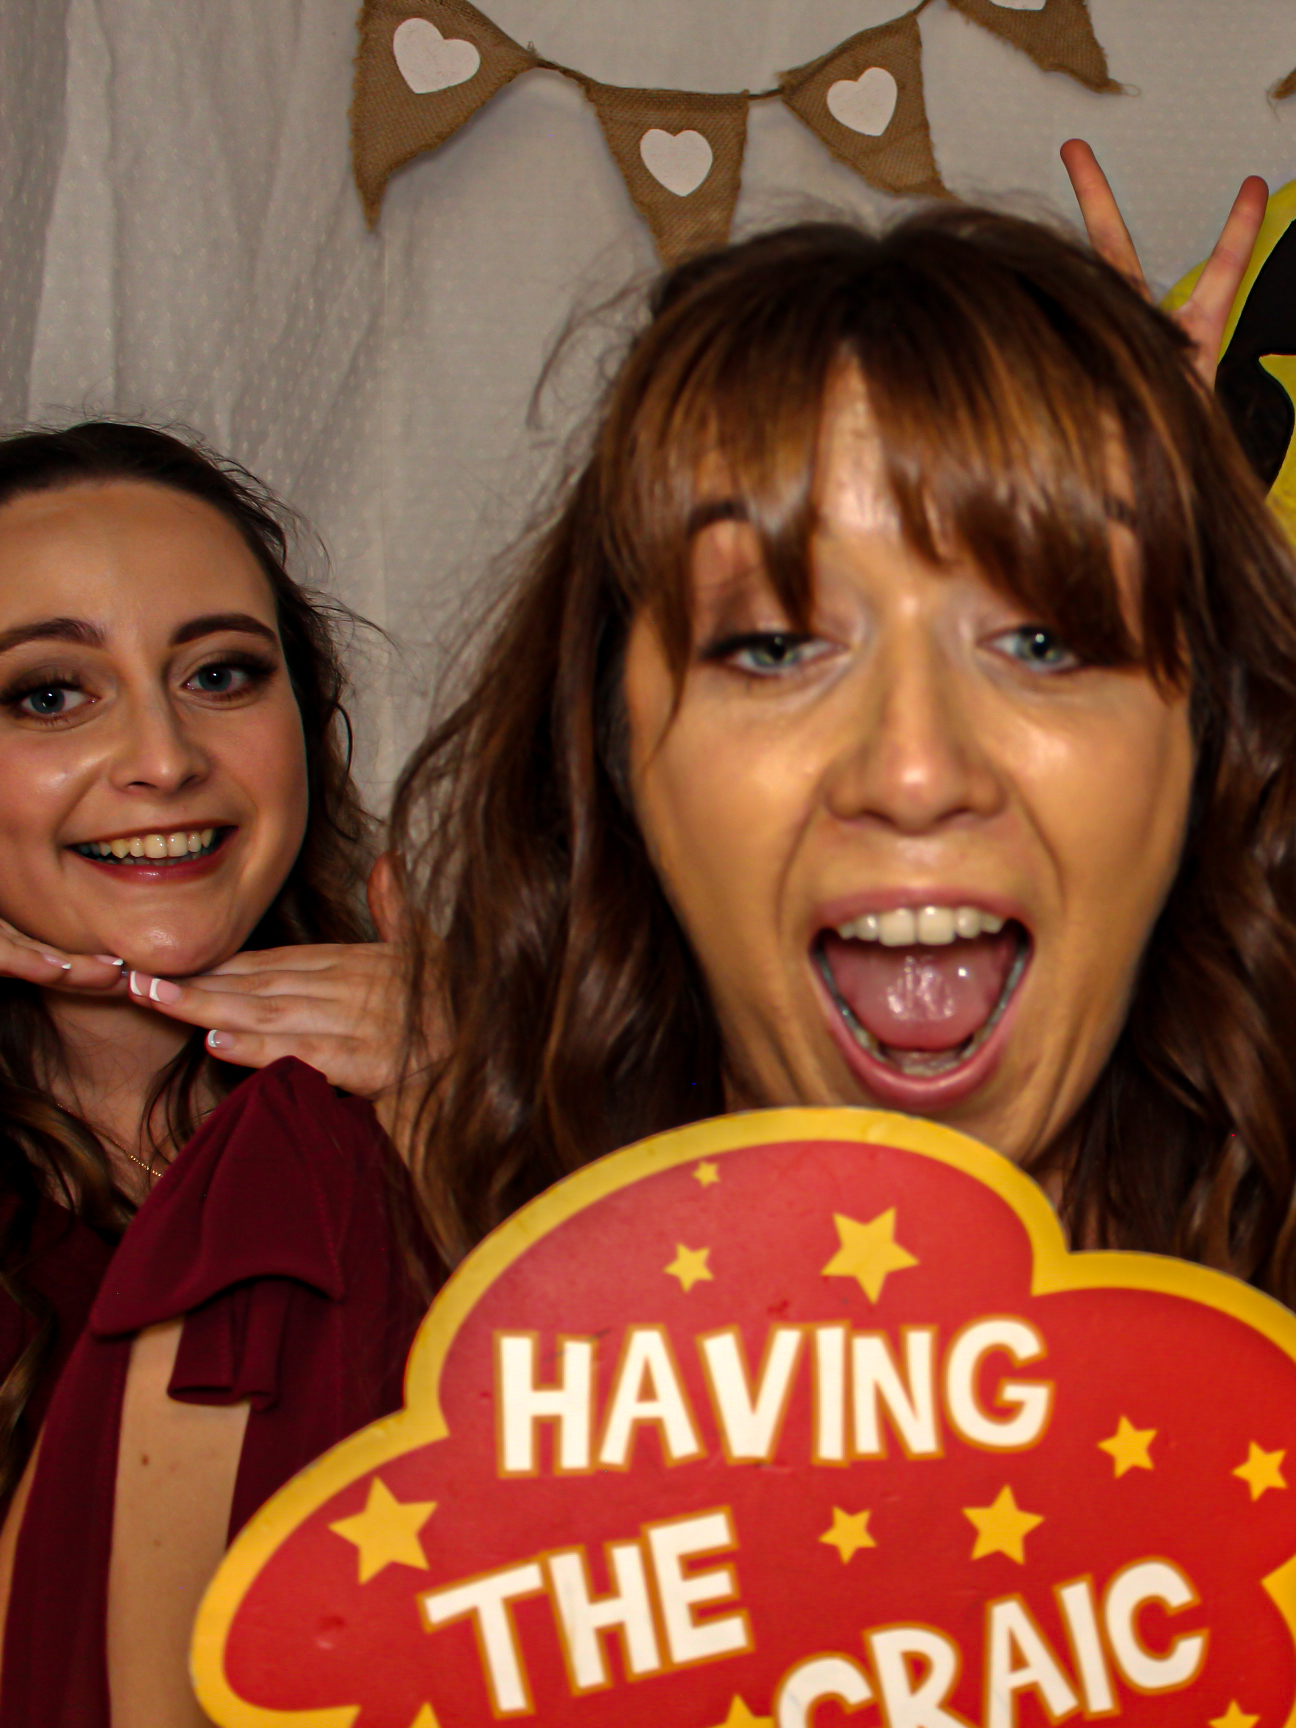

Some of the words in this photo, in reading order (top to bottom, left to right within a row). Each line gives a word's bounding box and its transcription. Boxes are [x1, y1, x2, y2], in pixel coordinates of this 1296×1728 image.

[498, 1319, 1050, 1472] HAVING
[423, 1512, 748, 1711] THE
[777, 1561, 1205, 1728] CRAIC
